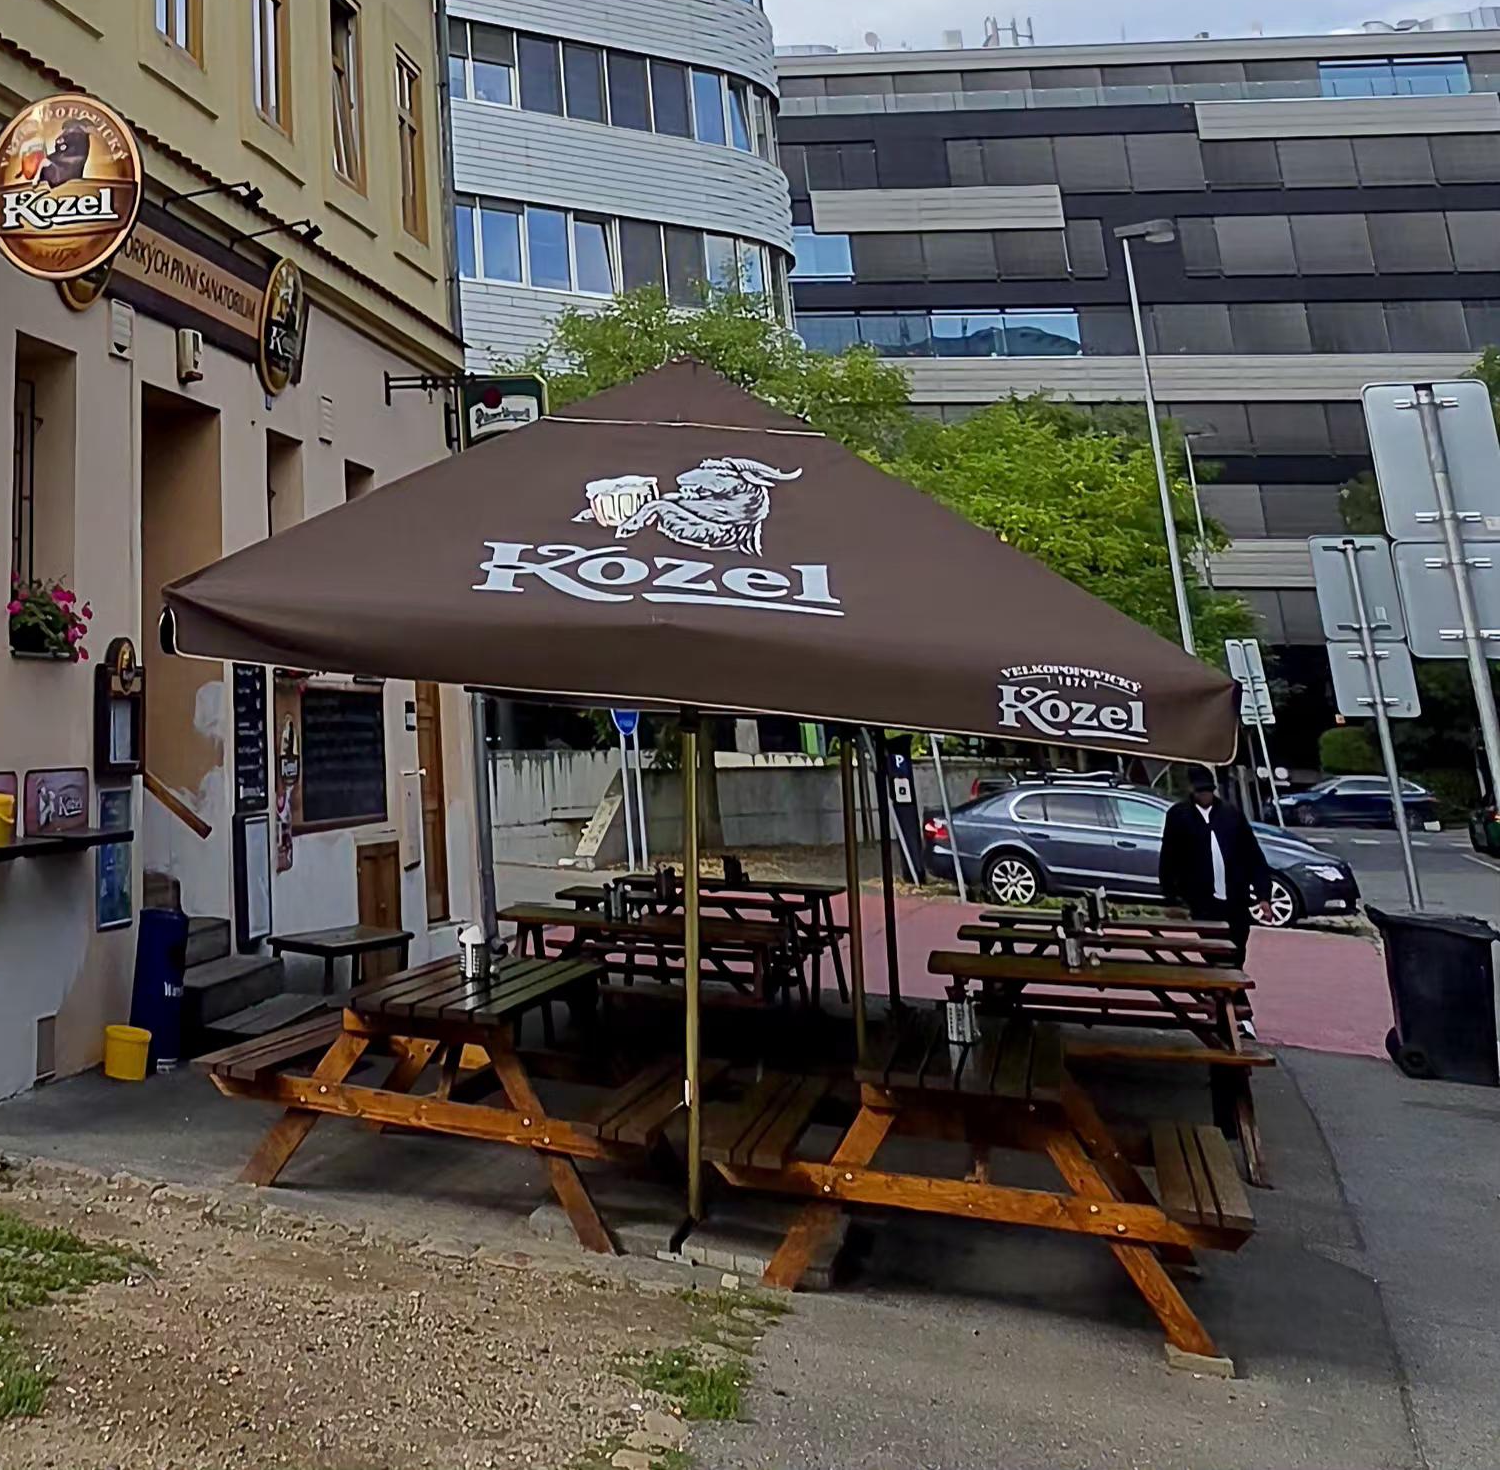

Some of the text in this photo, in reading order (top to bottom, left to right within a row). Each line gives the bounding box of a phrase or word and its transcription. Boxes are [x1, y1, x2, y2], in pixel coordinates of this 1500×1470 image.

[2, 187, 119, 229] Kozel
[121, 235, 170, 277] ORKÝCH
[170, 257, 199, 291] PIVNÍ
[197, 271, 256, 322] SANATORIUM
[472, 541, 845, 617] Kozel
[1000, 664, 1142, 693] VELKOPOPOVICKÝ
[1058, 675, 1087, 688] 1874
[997, 685, 1149, 743] Kozel
[895, 754, 905, 768] P
